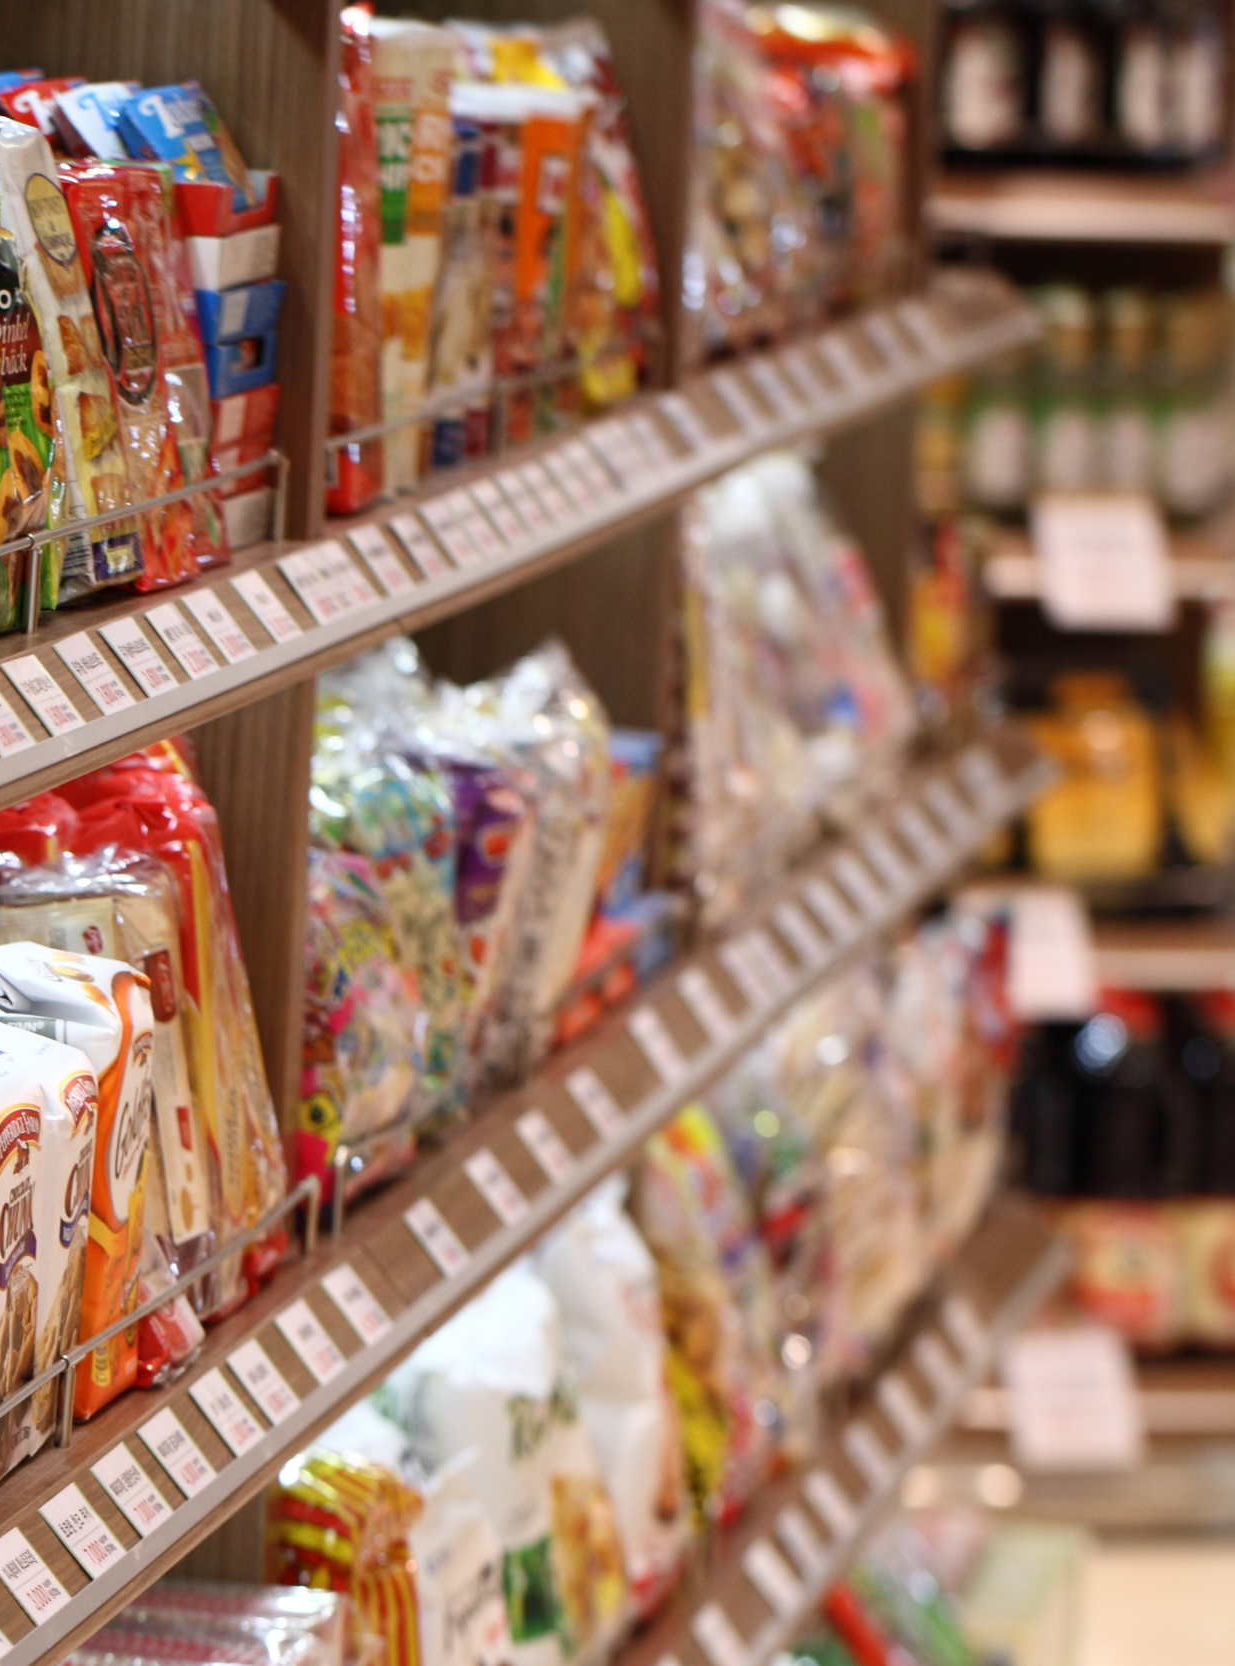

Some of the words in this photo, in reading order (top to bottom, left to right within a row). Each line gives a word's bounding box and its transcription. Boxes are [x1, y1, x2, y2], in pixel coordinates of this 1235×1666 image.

[21, 1111, 40, 1135] FARM
[82, 1539, 108, 1567] 7,000
[26, 1583, 53, 1612] 3,000
